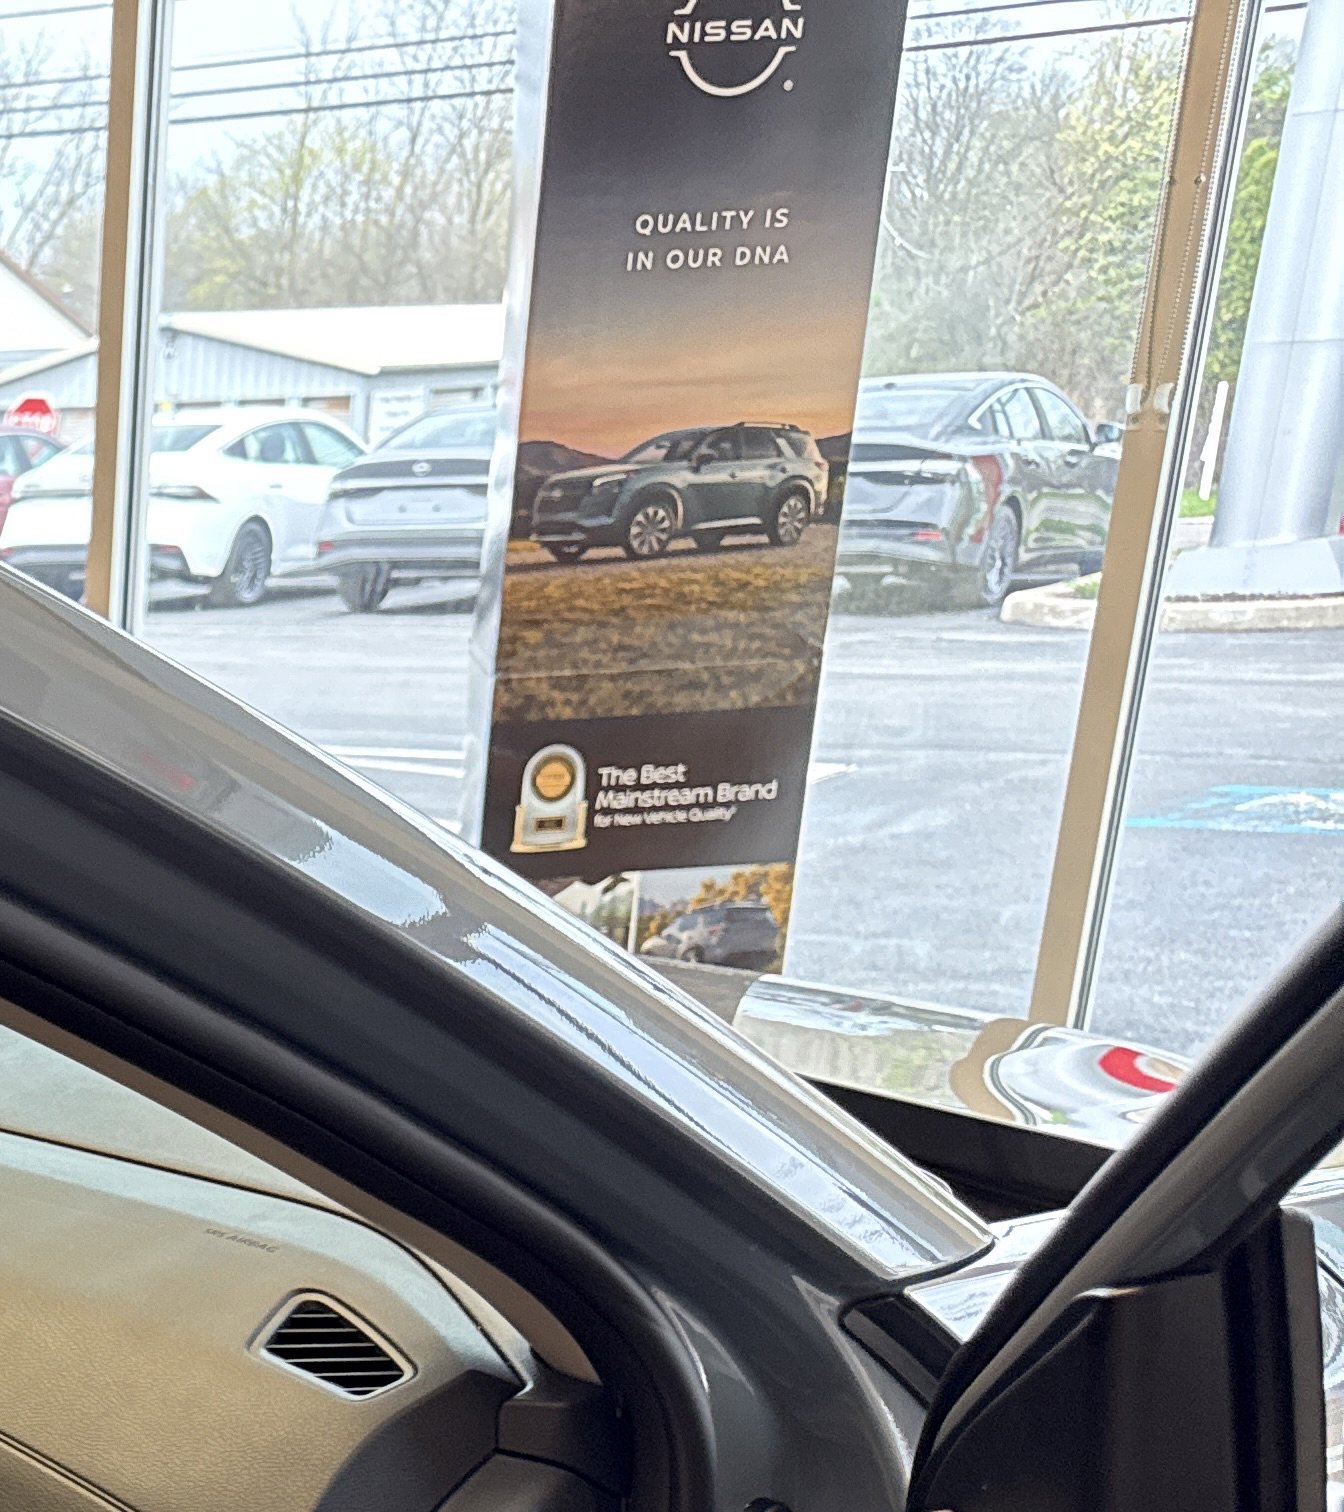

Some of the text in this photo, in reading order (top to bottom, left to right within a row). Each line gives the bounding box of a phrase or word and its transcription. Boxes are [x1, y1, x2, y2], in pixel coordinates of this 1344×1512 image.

[666, 17, 804, 44] NISSAN
[635, 208, 789, 236] QUALITY IS
[626, 244, 789, 271] IN OUR DNA
[598, 763, 688, 787] The Best
[595, 779, 778, 810] Mainstream Brand
